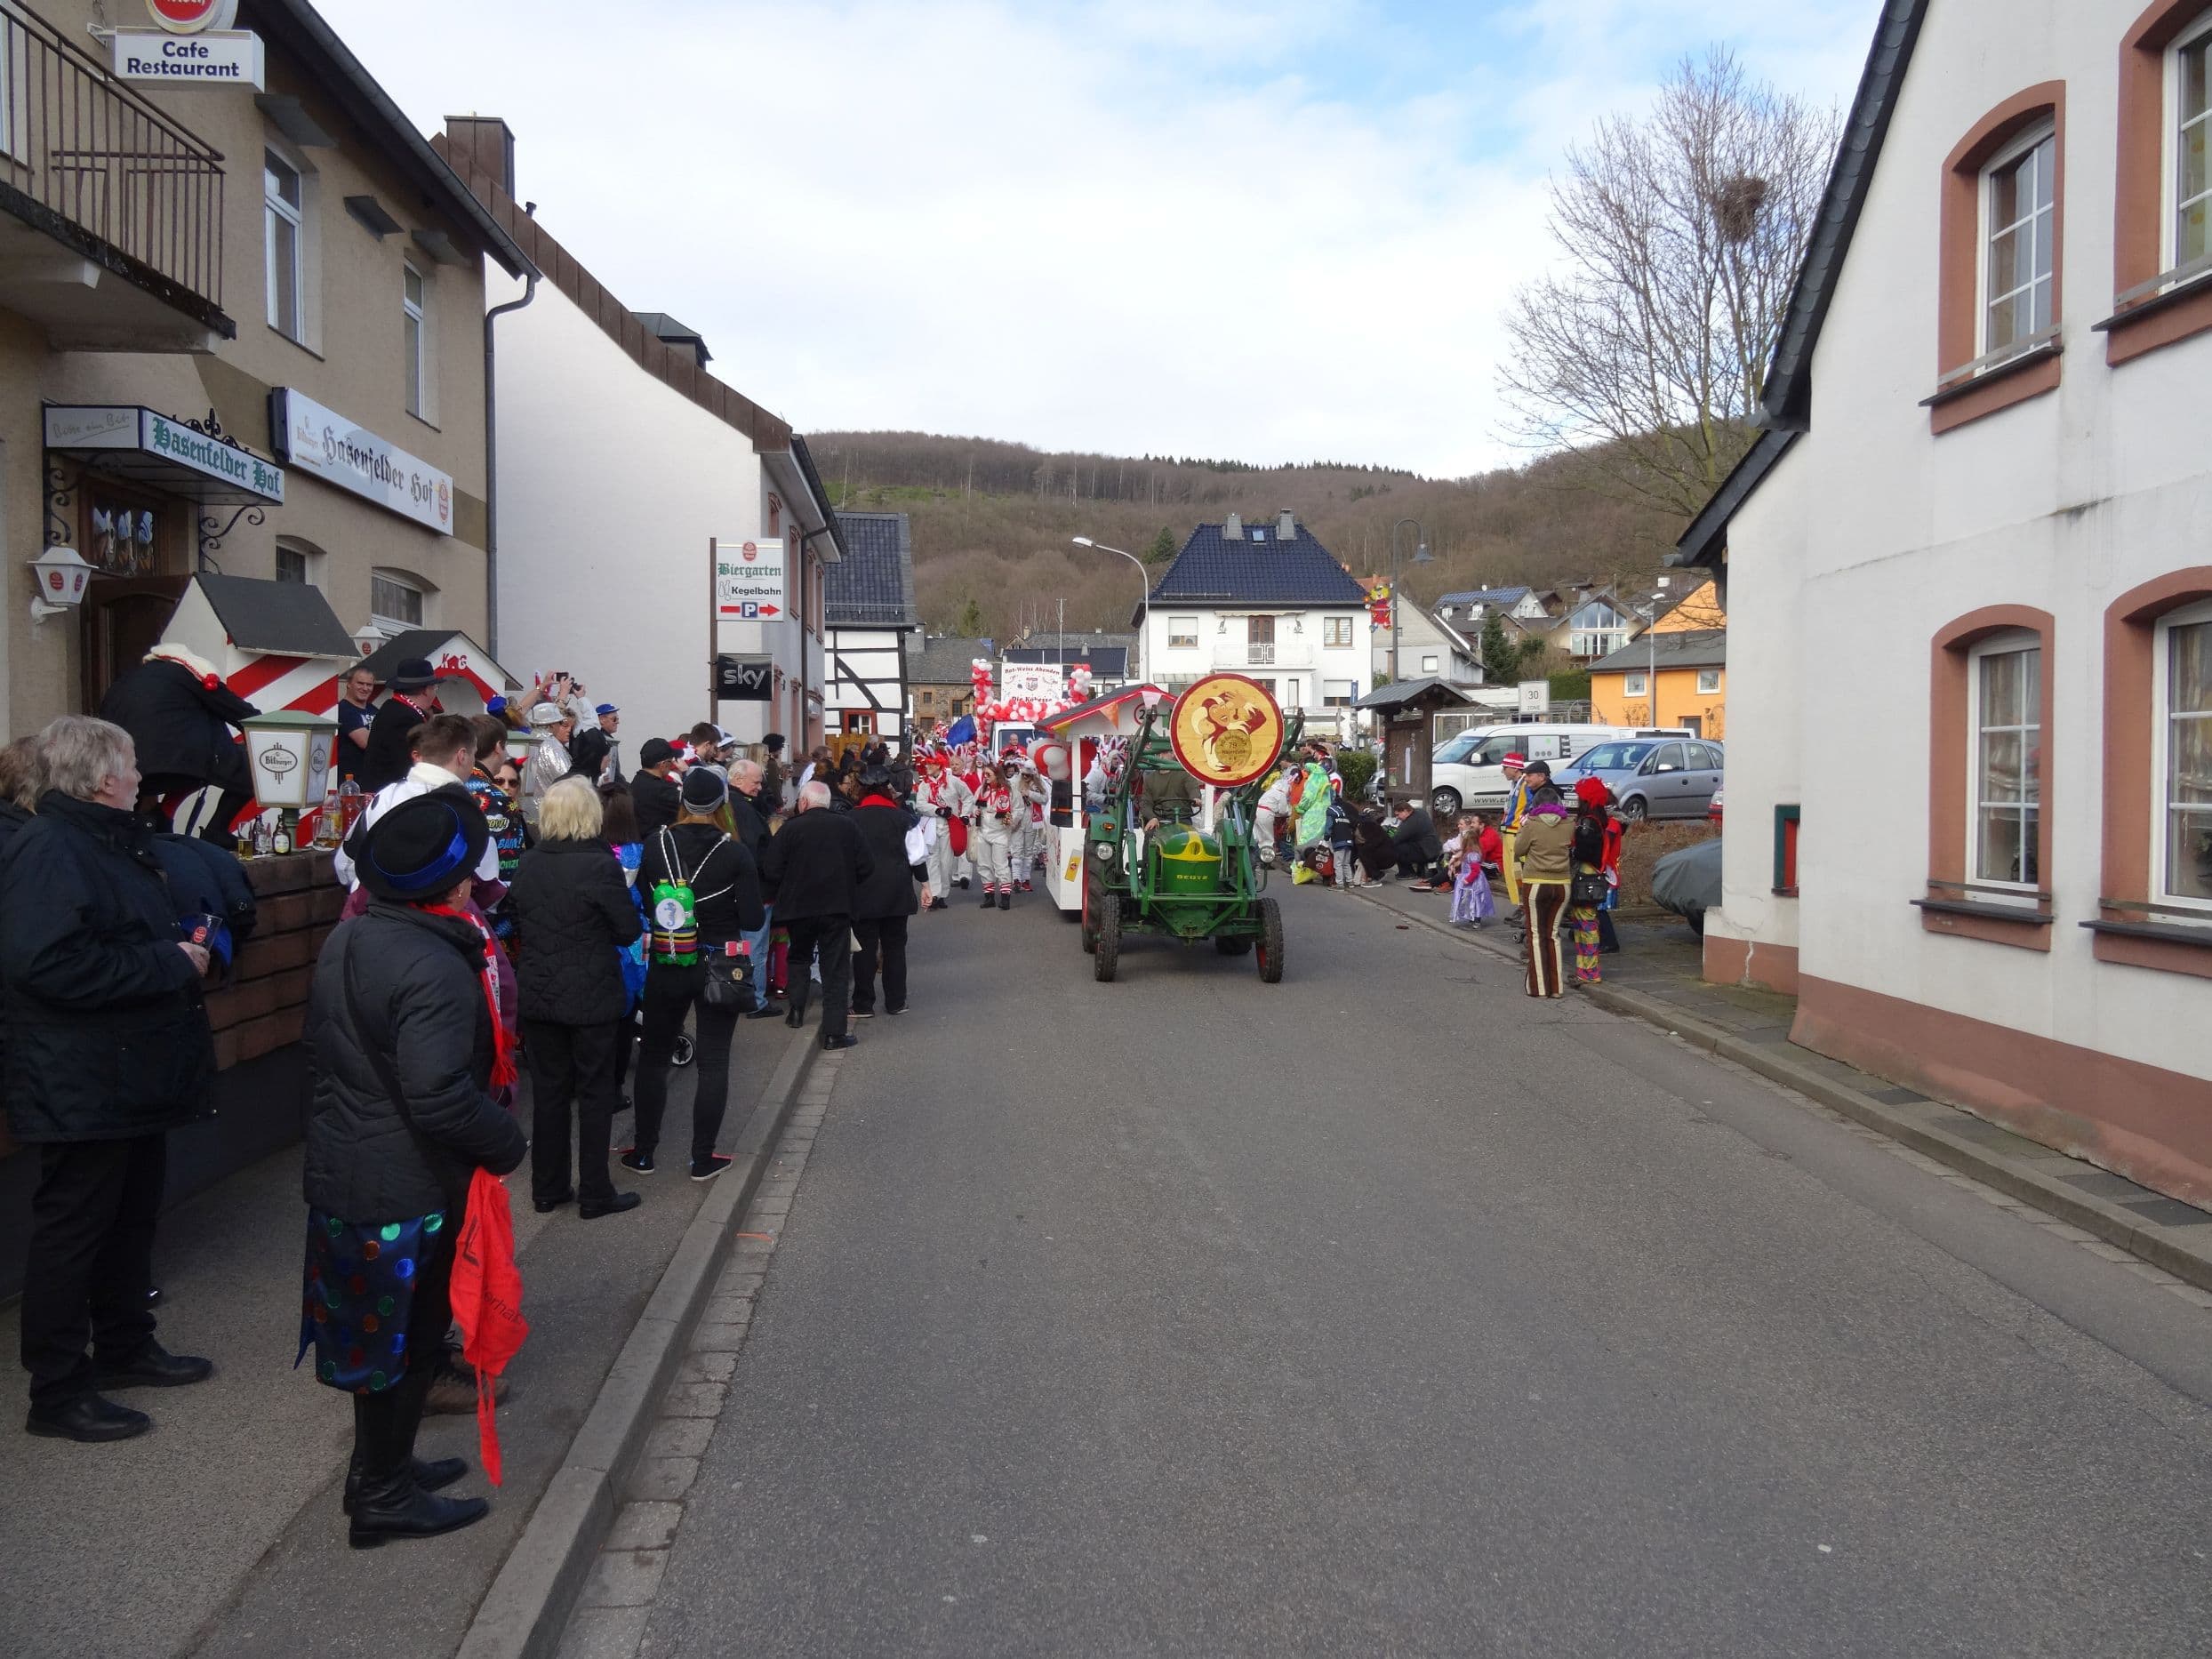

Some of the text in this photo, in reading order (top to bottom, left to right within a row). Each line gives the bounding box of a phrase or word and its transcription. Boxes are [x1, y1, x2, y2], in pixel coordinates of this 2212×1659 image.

[163, 41, 209, 58] Cafe
[127, 58, 239, 76] Restaurant
[152, 416, 248, 480] Hasenfelder
[252, 460, 281, 493] Hof
[322, 426, 433, 512] Hasenfelder Hof
[718, 563, 781, 578] Biergarten
[732, 587, 781, 596] Kegelbahn
[744, 604, 757, 617] P
[724, 664, 766, 689] sky
[1528, 690, 1539, 700] 30
[265, 755, 293, 765] Bitburger
[498, 837, 521, 849] BAM!
